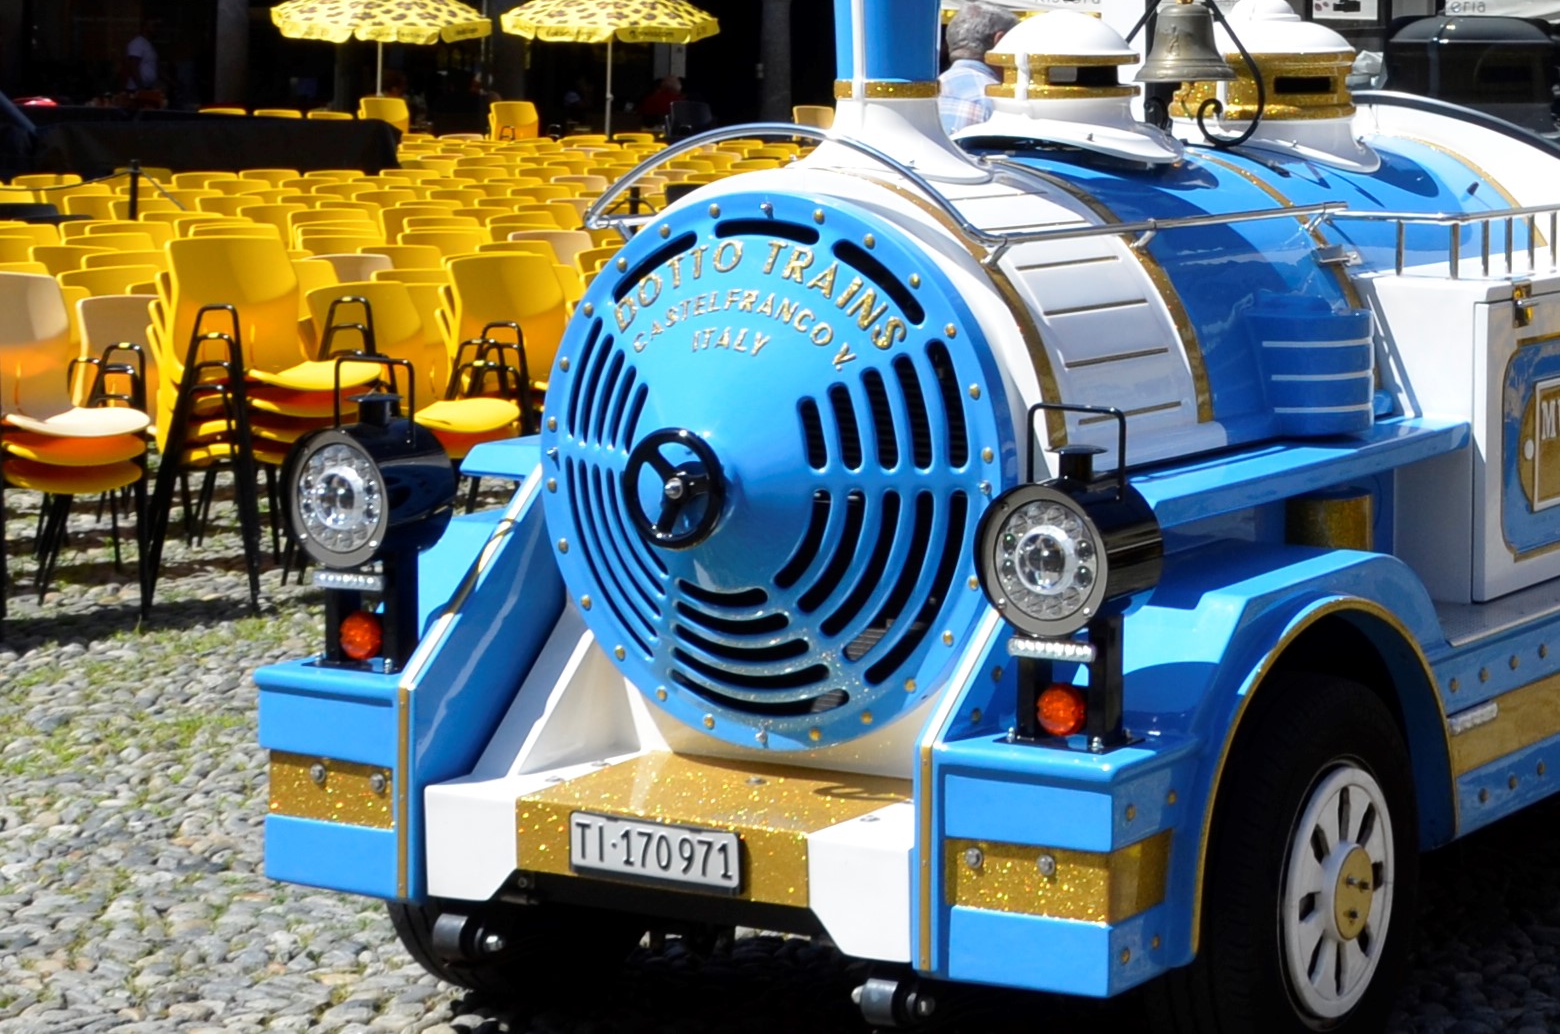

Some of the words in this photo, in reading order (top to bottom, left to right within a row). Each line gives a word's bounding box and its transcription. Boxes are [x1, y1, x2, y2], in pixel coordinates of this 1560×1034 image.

[614, 239, 744, 333] DOTTO
[762, 240, 907, 350] TRAINS
[633, 287, 834, 353] CASTELFRANCO
[692, 326, 771, 356] ITALY
